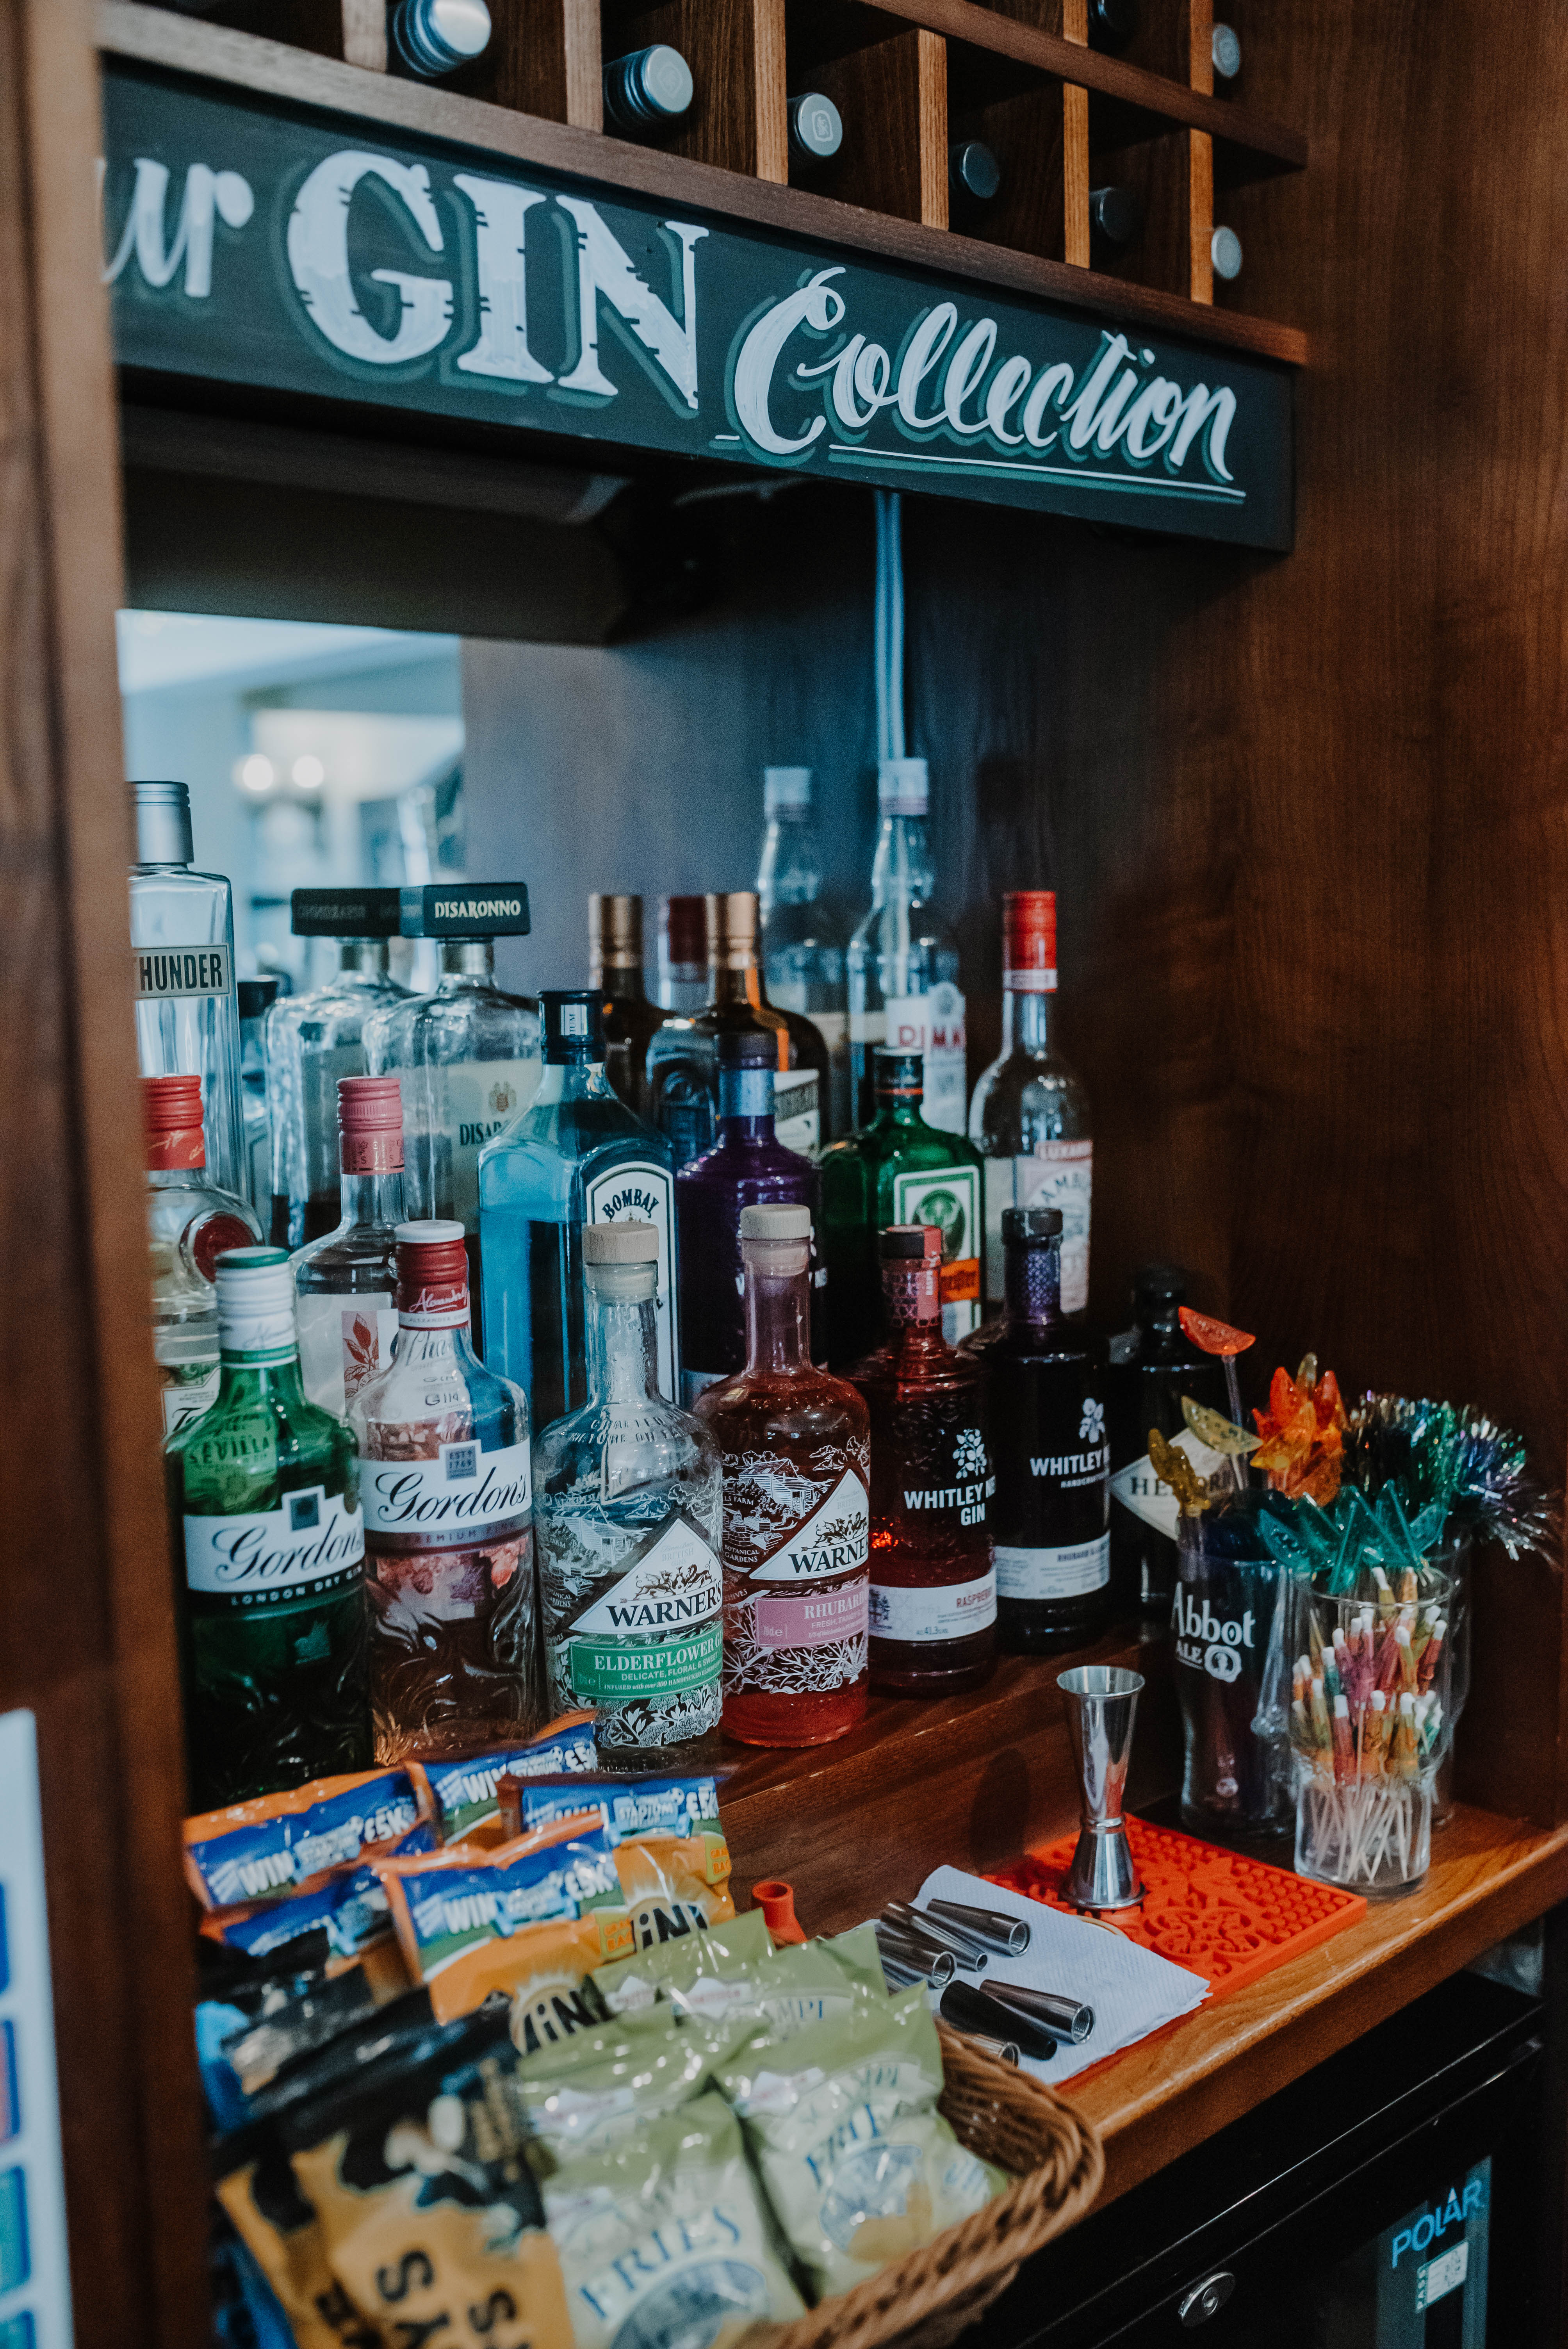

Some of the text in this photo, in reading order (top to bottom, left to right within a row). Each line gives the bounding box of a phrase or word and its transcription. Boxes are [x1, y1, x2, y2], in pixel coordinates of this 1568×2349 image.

[101, 150, 1237, 481] ur GIN Collection
[435, 900, 521, 919] DISARONNO
[139, 953, 223, 992] HUNDER
[460, 1121, 502, 1146] DISAR
[602, 1189, 659, 1219] BOMBAY
[189, 1436, 271, 1464] SEVILLA
[1030, 1449, 1103, 1476] WHITLEY
[375, 1466, 526, 1522] Gordon's
[734, 1496, 754, 1506] FARM
[904, 1483, 983, 1510] WHITLEY
[960, 1502, 985, 1526] GIN
[551, 1538, 566, 1549] ARM
[662, 1547, 694, 1562] BRITISH
[725, 1544, 759, 1555] BOTANICAL
[725, 1551, 758, 1563] GARDENS
[788, 1538, 868, 1574] WARNE
[231, 1585, 306, 1606] LONDON
[314, 1575, 340, 1593] DRY
[549, 1590, 572, 1600] TANICAL
[606, 1579, 722, 1627] WARNER'S
[1170, 1581, 1256, 1648] Abbot
[595, 1638, 714, 1671] ELDERFLOWER
[621, 1670, 666, 1681] DELICATE,
[668, 1663, 697, 1676] FLORAL
[703, 1651, 718, 1666] SWEET
[668, 1672, 701, 1686] HANDPICKED
[238, 1849, 294, 1896] WIN
[444, 1892, 497, 1934] WIN
[1392, 2179, 1484, 2269] POLAR
[579, 2206, 740, 2320] FRIES
